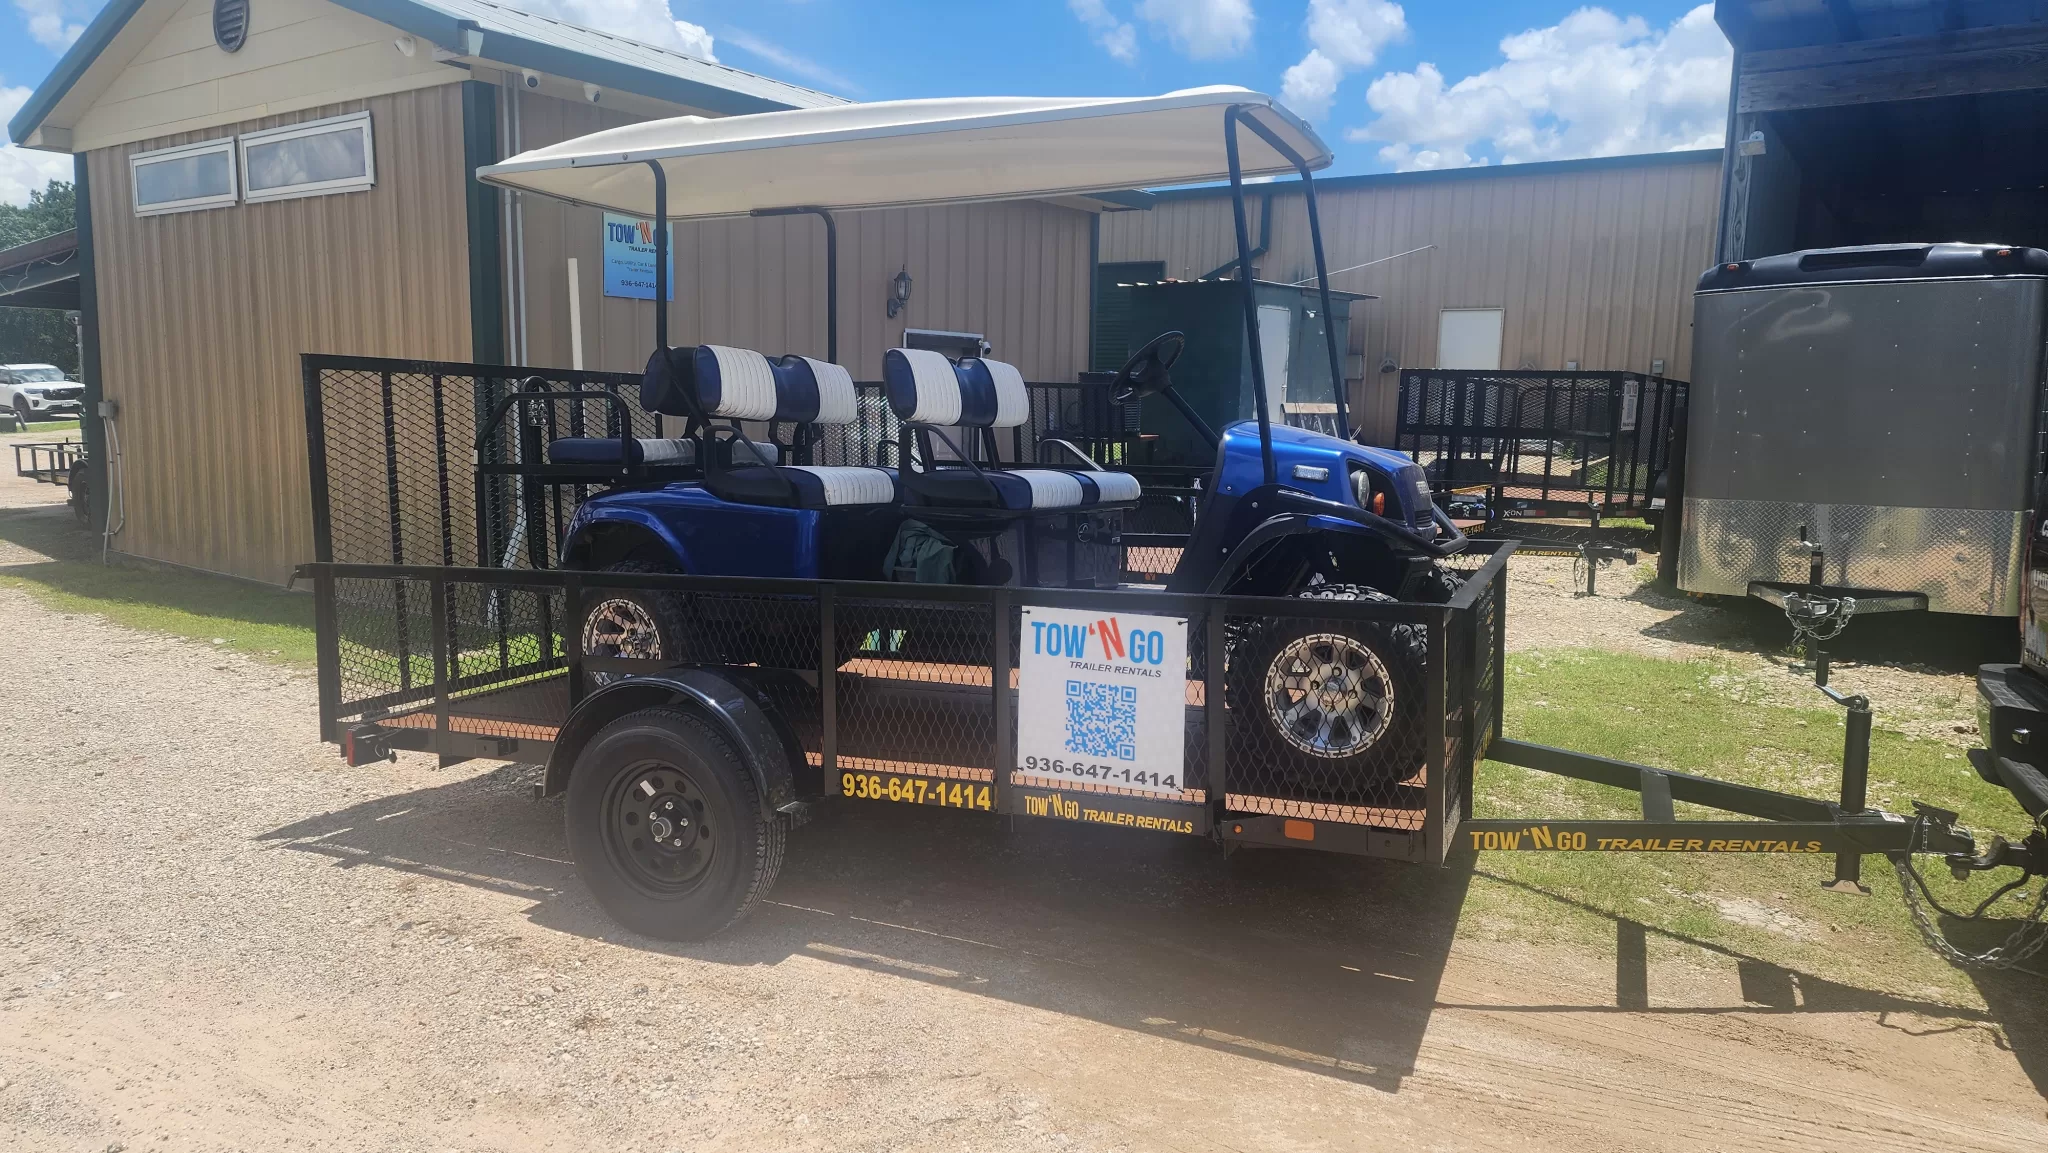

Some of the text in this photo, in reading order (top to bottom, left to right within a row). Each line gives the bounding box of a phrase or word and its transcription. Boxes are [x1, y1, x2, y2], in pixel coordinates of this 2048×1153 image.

[620, 280, 657, 288] 936-647-141
[1129, 629, 1164, 665] GO
[1069, 660, 1162, 678] TRAILER RENTALS
[1025, 755, 1177, 789] 936-647-1414
[842, 772, 991, 811] 936-647-1414
[1064, 800, 1079, 820] GO
[1083, 808, 1134, 826] TRAILER
[1136, 815, 1193, 834] RENTALS
[1557, 831, 1587, 850] GO
[1597, 838, 1704, 851] TRAILER
[1707, 839, 1822, 853] RENTALS
